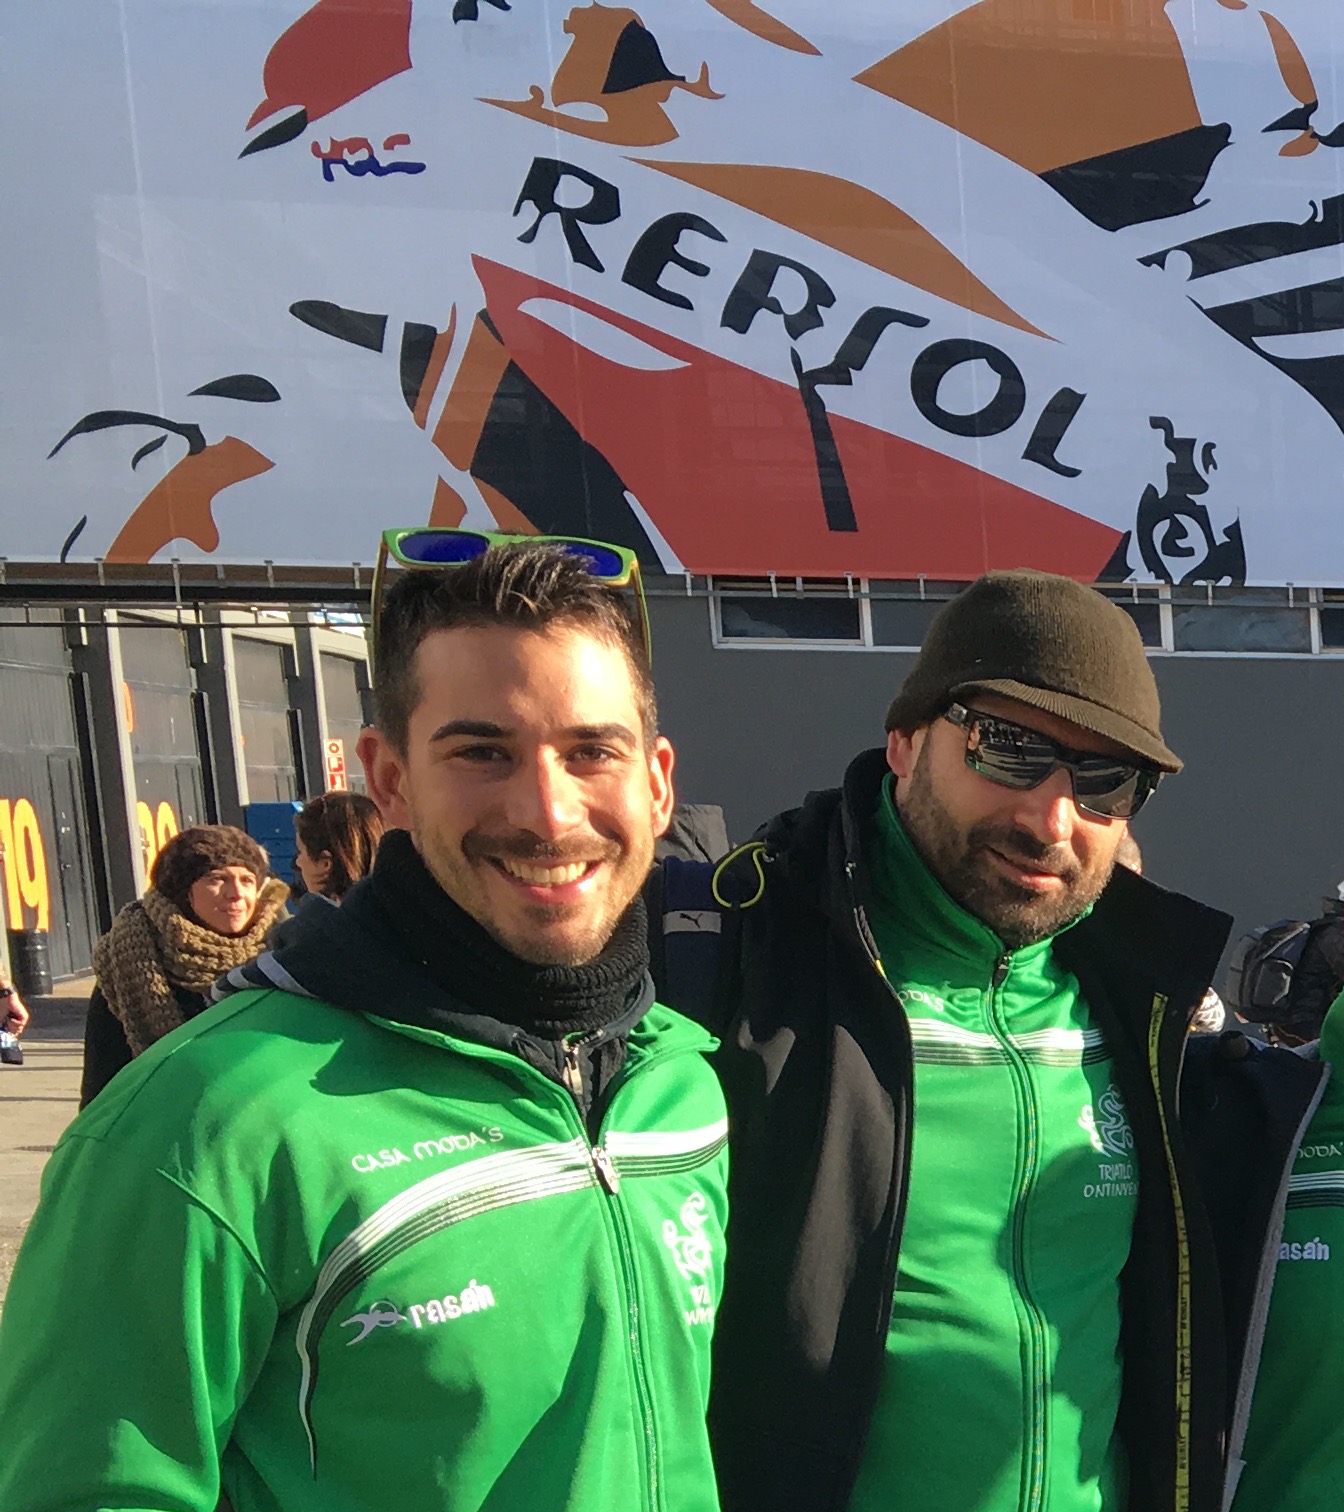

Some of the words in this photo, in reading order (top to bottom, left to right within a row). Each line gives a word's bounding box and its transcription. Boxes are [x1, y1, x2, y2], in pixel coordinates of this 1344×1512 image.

[512, 156, 1088, 482] REPSOL
[351, 1147, 411, 1173] CASA
[413, 1126, 504, 1160] MODA'S
[1279, 1236, 1330, 1260] asán
[407, 1278, 496, 1329] rasán
